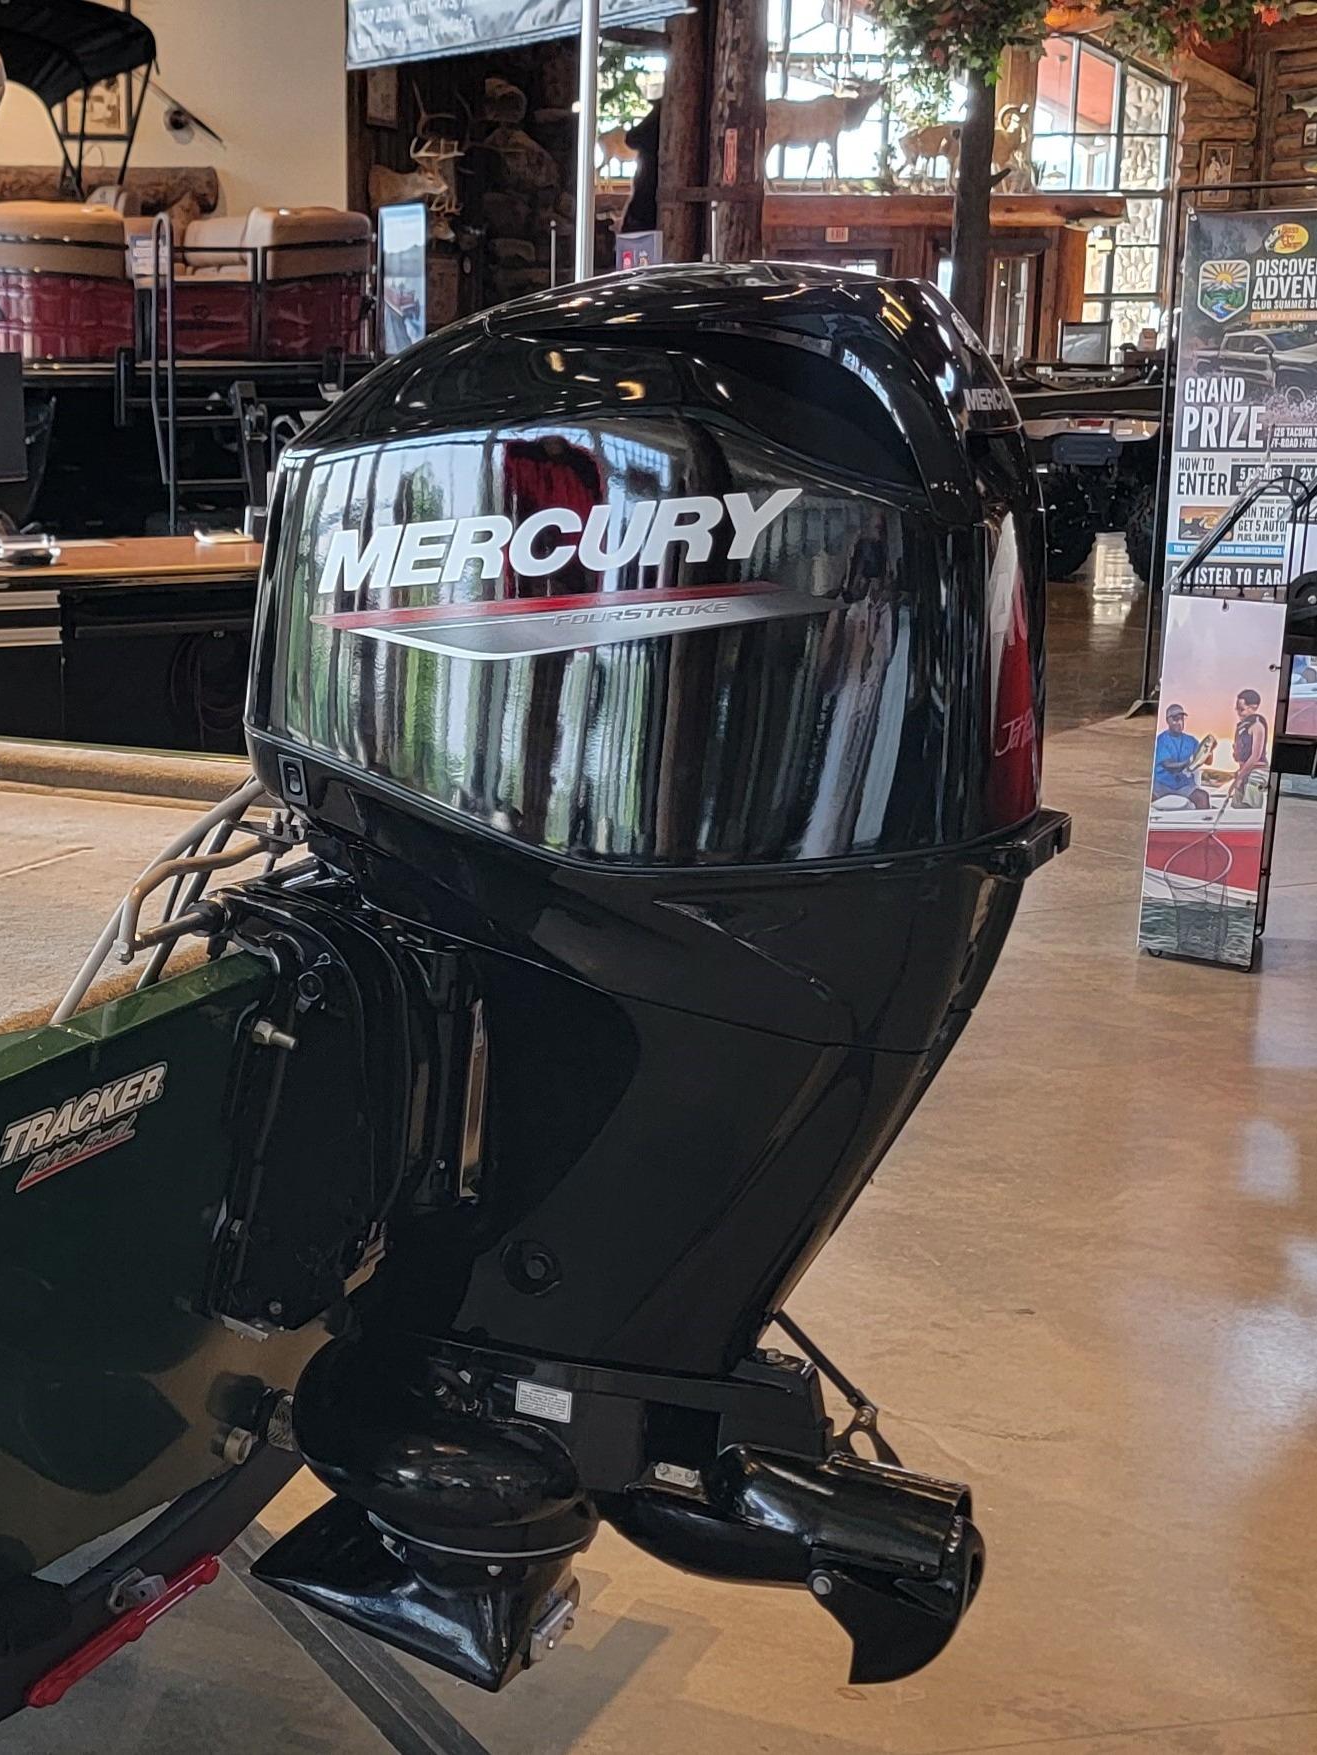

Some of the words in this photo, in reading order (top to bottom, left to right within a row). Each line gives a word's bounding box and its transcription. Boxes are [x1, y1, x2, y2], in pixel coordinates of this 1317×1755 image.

[1255, 258, 1317, 277] DISCOVE
[1251, 300, 1272, 310] CLUB
[1273, 300, 1309, 310] SUMMER
[1184, 377, 1245, 403] GRAND
[1181, 406, 1266, 448] PRIZE
[1285, 427, 1312, 437] TACOMA
[1178, 457, 1199, 471] HOW
[1203, 457, 1215, 471] TO
[1240, 467, 1247, 480] 5
[1177, 472, 1228, 496] ENTER
[1260, 507, 1274, 519] THE
[1238, 520, 1253, 532] GET
[1255, 520, 1262, 532] 5
[317, 488, 803, 594] MERCURY
[1235, 567, 1252, 585] TO
[552, 601, 732, 627] FOURSTROKE
[0, 1064, 167, 1166] TRACKER
